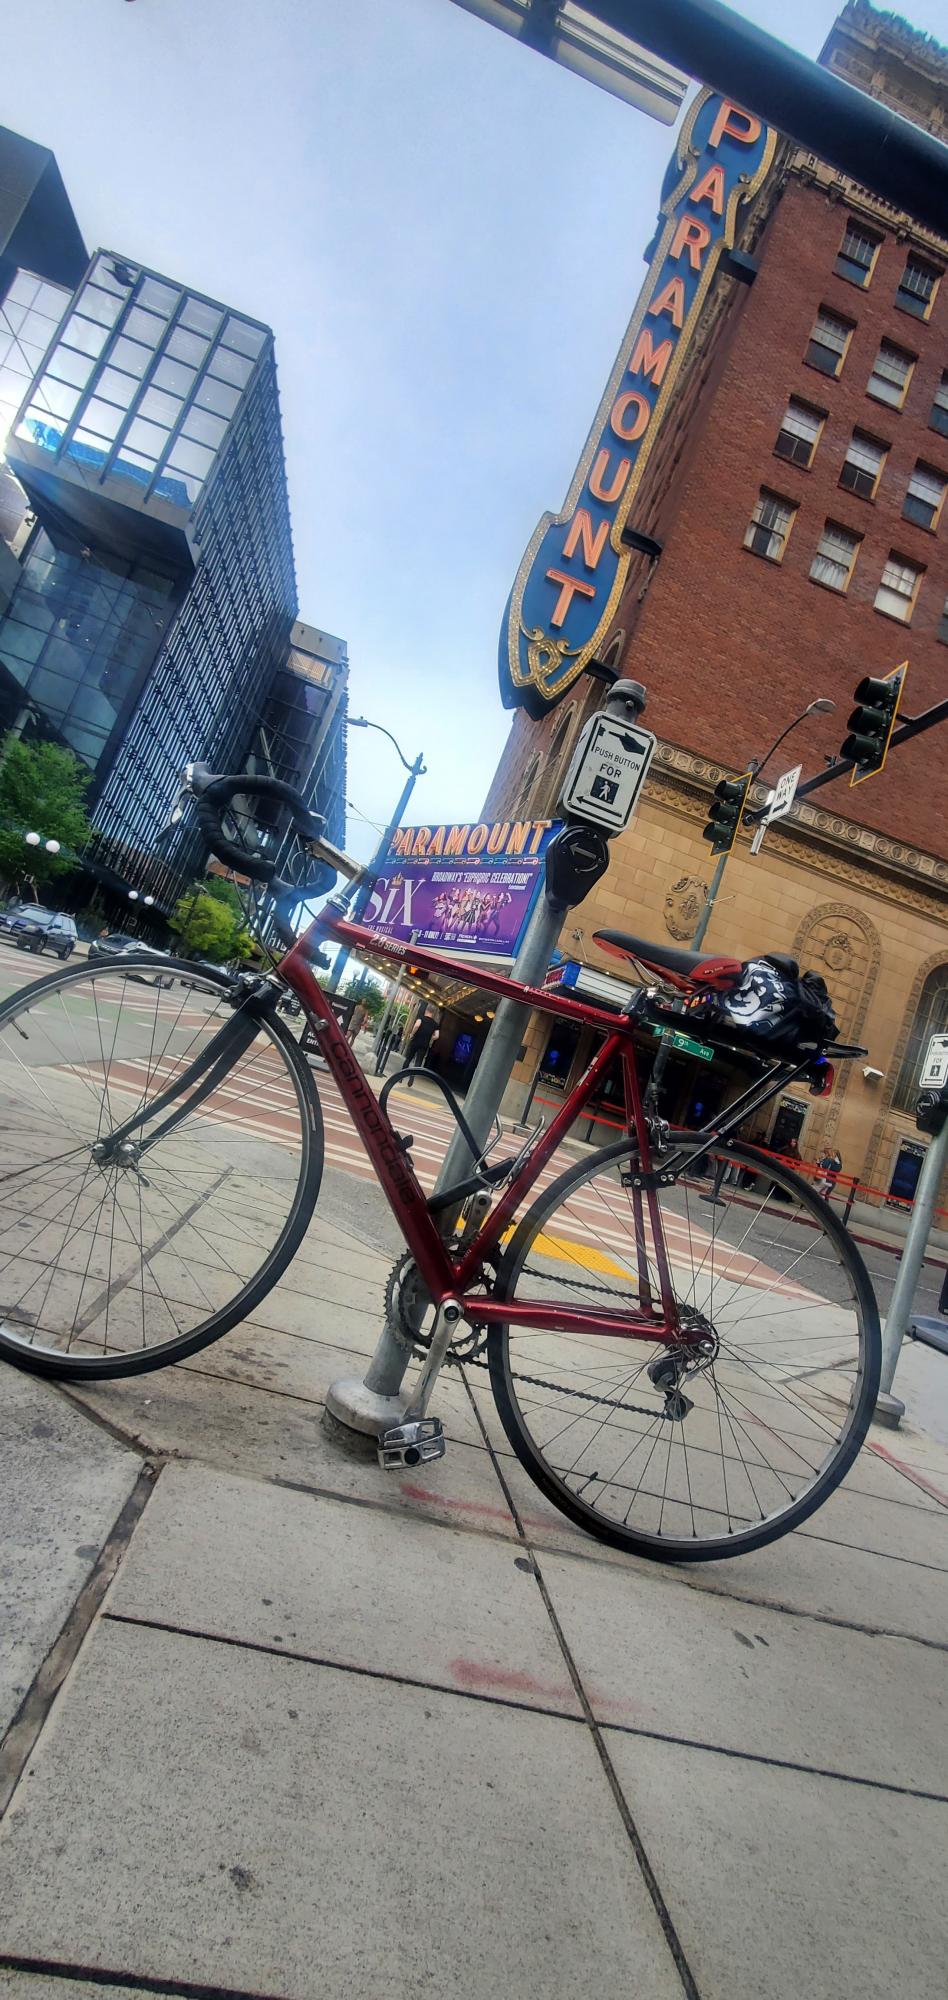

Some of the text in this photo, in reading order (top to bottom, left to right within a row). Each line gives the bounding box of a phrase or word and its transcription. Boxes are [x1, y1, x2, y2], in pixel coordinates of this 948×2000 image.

[546, 100, 762, 628] PARAMOUNT
[595, 746, 641, 772] PUSH BUTTON
[599, 763, 622, 778] FOR
[780, 771, 797, 789] ONE
[387, 820, 552, 856] PARAMOUNT
[362, 877, 426, 927] SIX
[370, 933, 407, 956] 2.8 SERIES
[331, 1042, 415, 1205] cannondale
